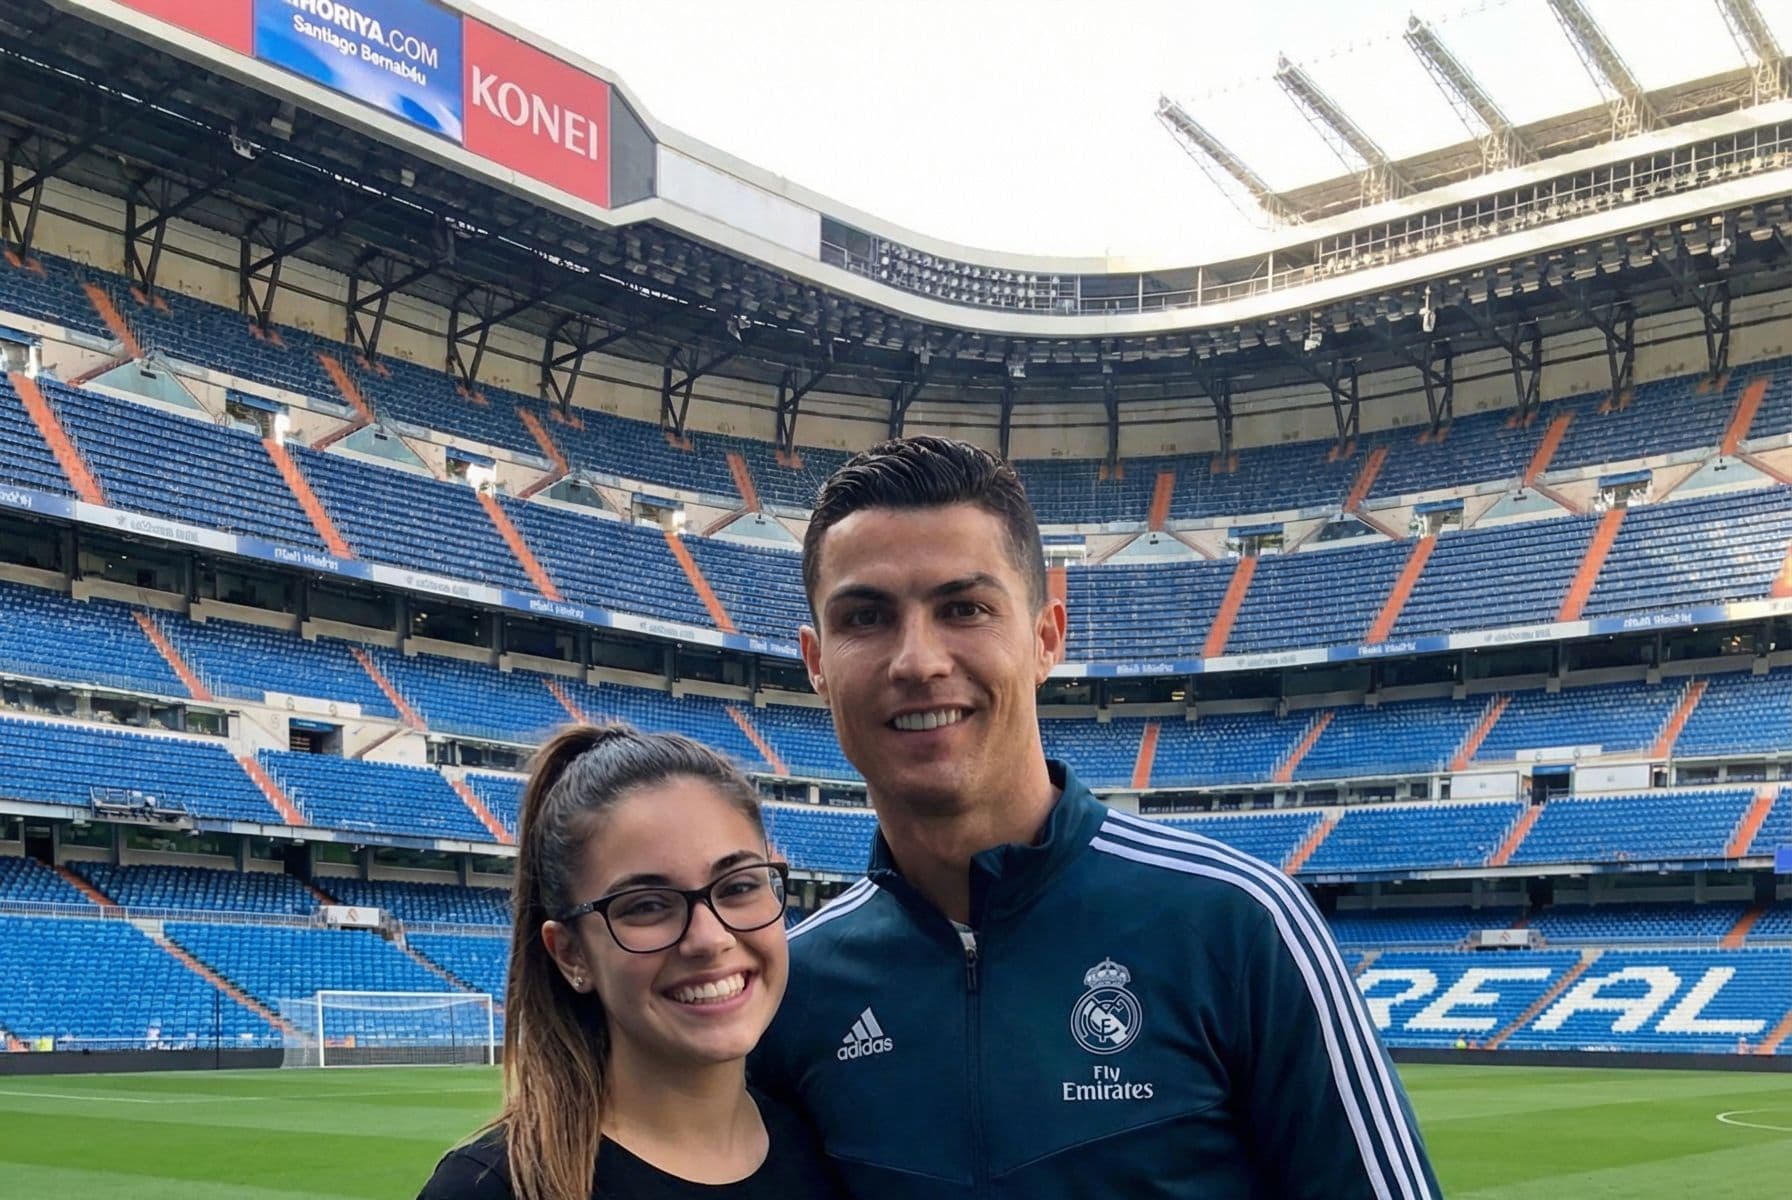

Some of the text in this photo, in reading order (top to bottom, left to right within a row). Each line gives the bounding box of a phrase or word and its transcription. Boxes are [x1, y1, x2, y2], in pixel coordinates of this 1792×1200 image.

[293, 14, 358, 56] Santiago
[472, 65, 598, 161] KONEI
[1356, 966, 1768, 1033] REAL
[837, 1036, 894, 1062] adidas
[1093, 1065, 1121, 1081] Fly
[1062, 1080, 1154, 1101] Emirates
